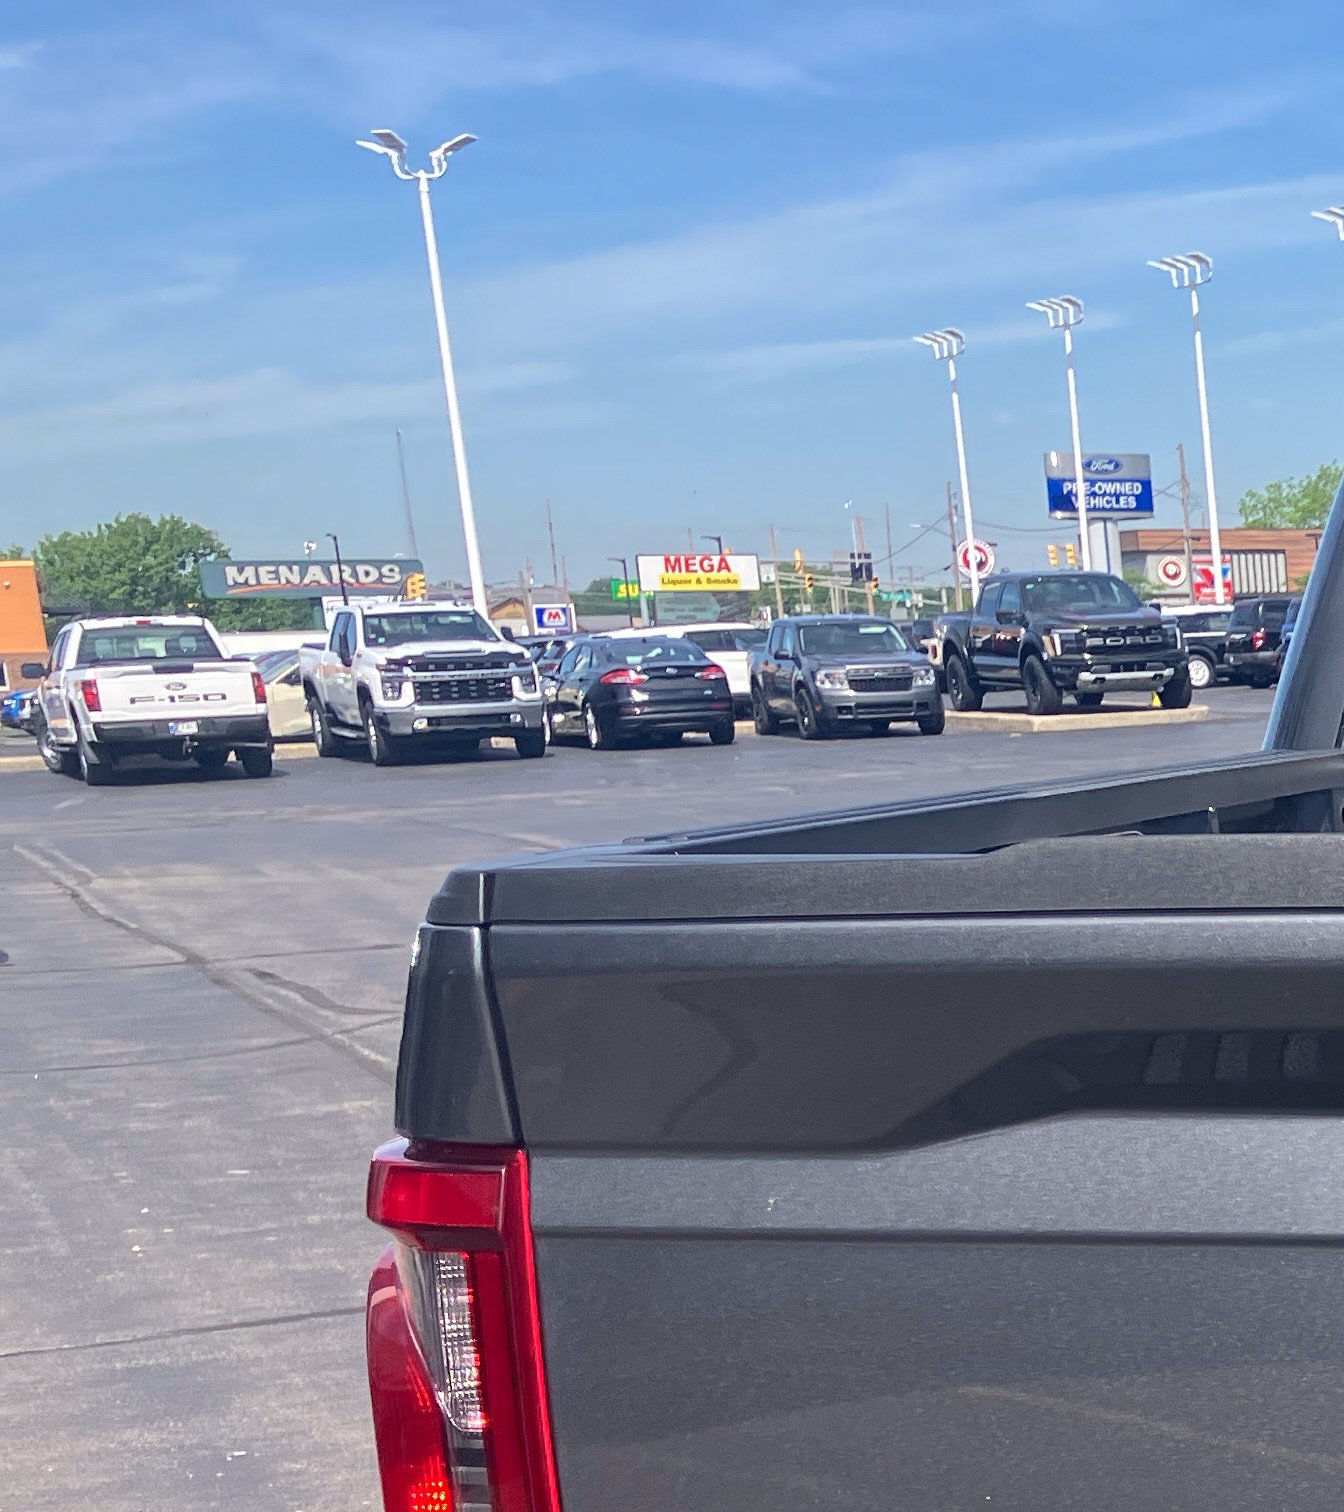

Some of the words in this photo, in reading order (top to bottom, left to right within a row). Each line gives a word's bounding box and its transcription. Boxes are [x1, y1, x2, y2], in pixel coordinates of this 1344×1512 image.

[664, 554, 732, 573] MEGA
[224, 564, 402, 586] MENARDS
[129, 693, 227, 705] F-150
